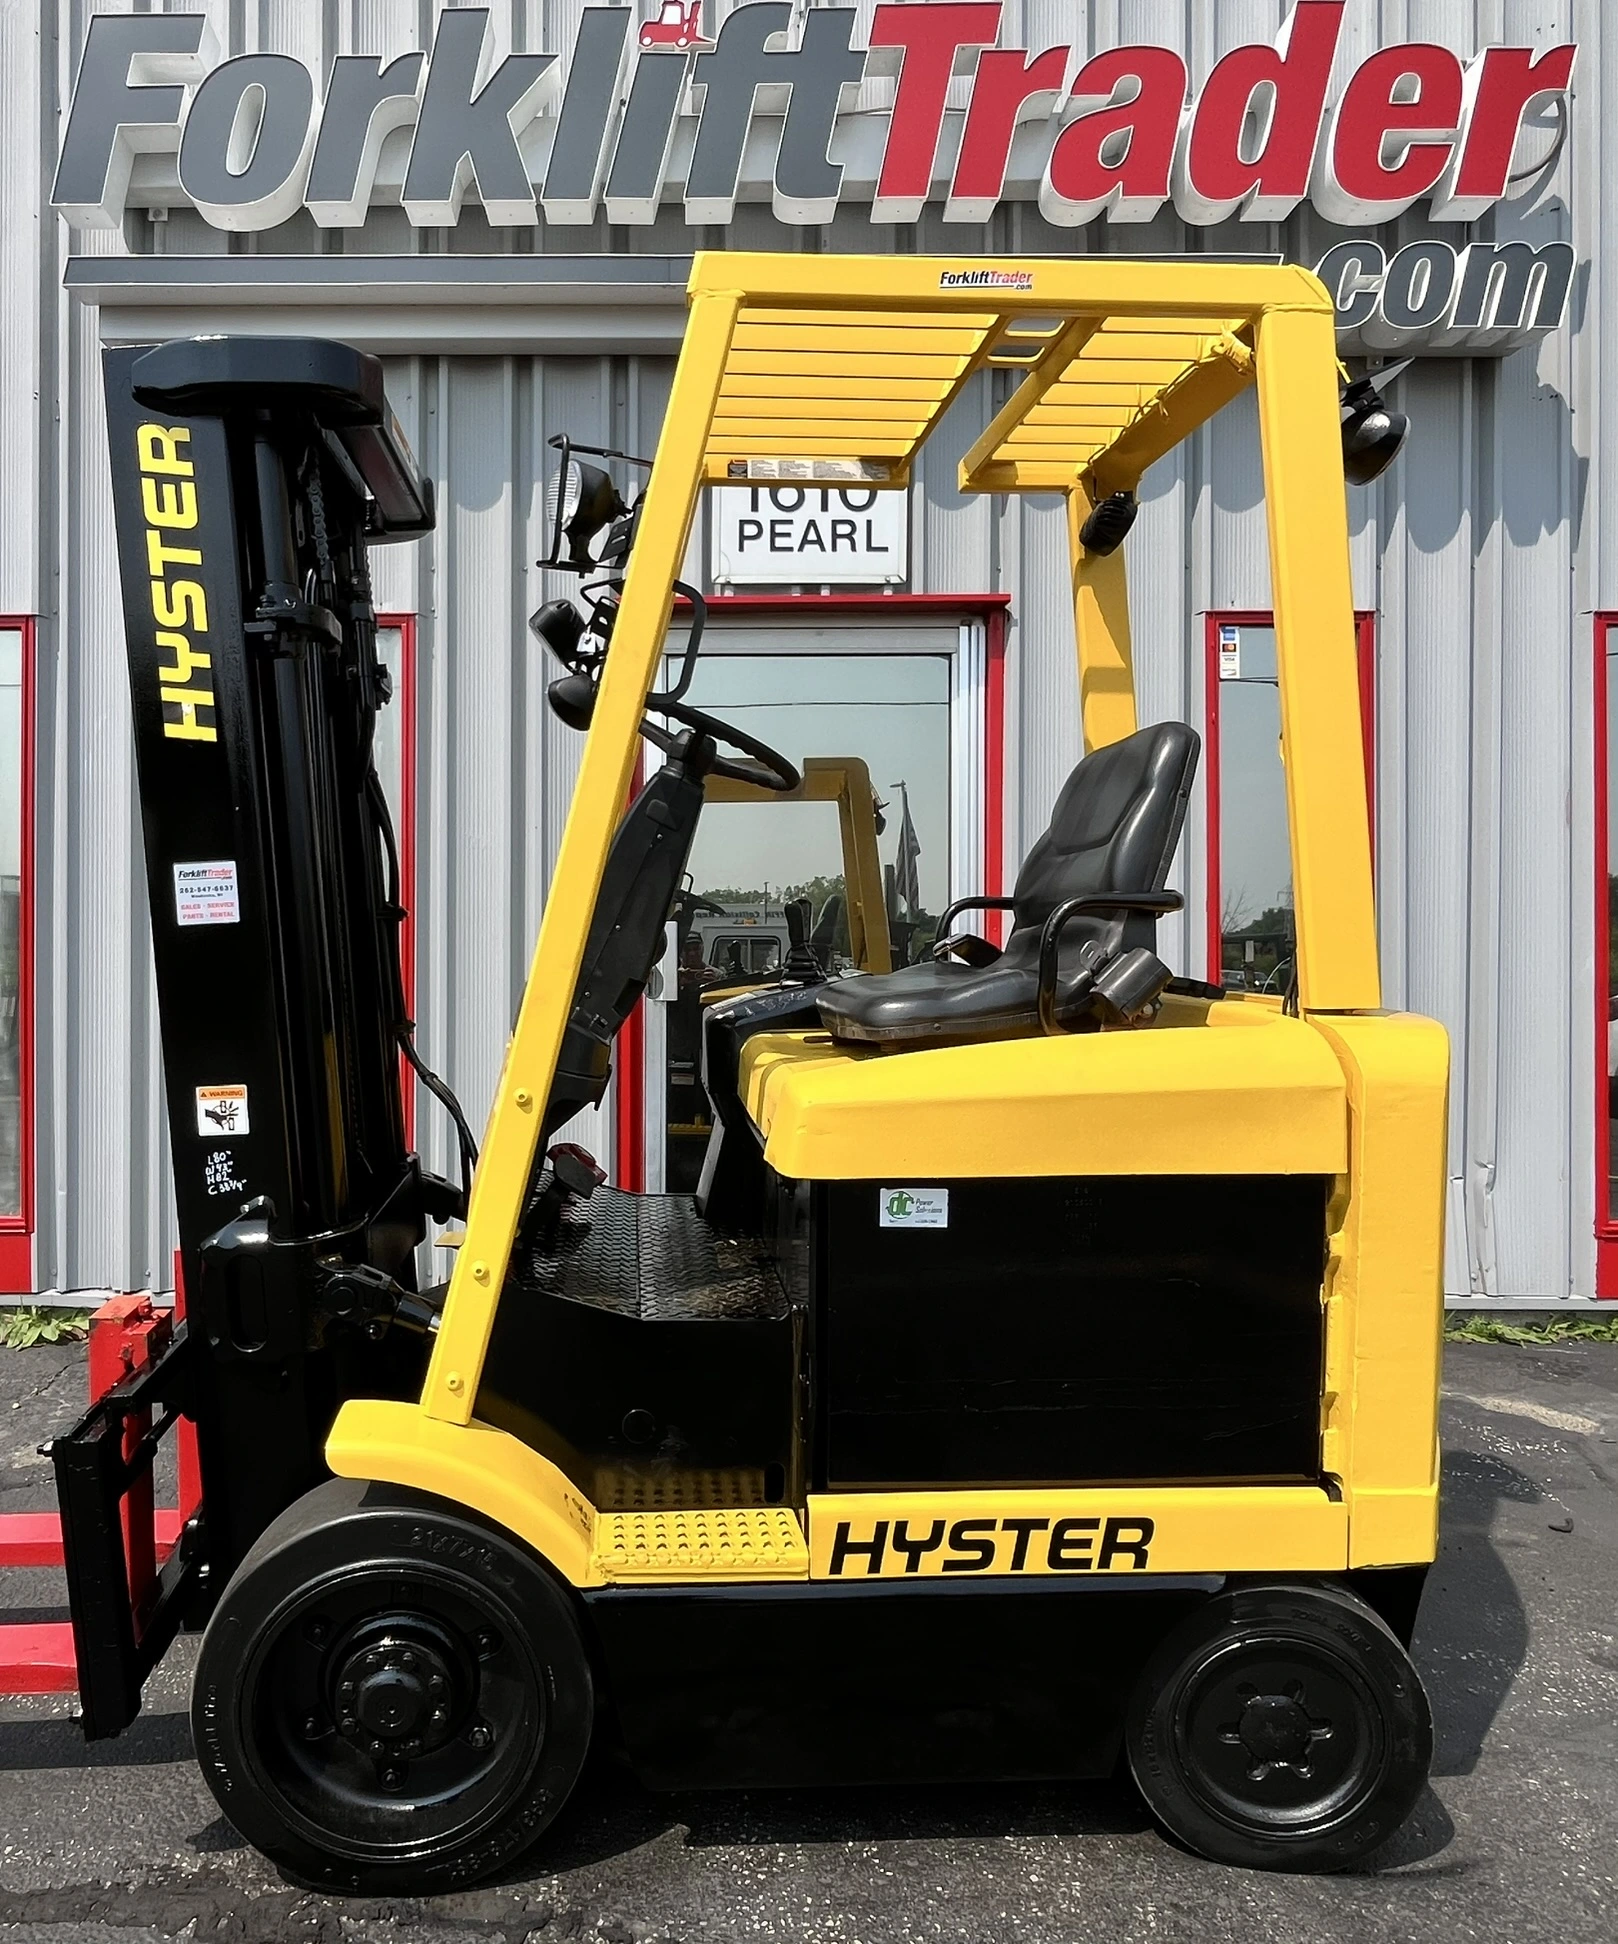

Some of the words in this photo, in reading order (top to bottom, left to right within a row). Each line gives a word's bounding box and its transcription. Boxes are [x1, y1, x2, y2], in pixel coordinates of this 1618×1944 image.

[50, 0, 1578, 206] ForkliftTrader
[940, 270, 1034, 285] ForkliftTrader
[738, 519, 889, 553] PEARL
[137, 423, 218, 742] HYSTER
[209, 1089, 243, 1098] WARNING
[829, 1517, 1155, 1575] HYSTER
